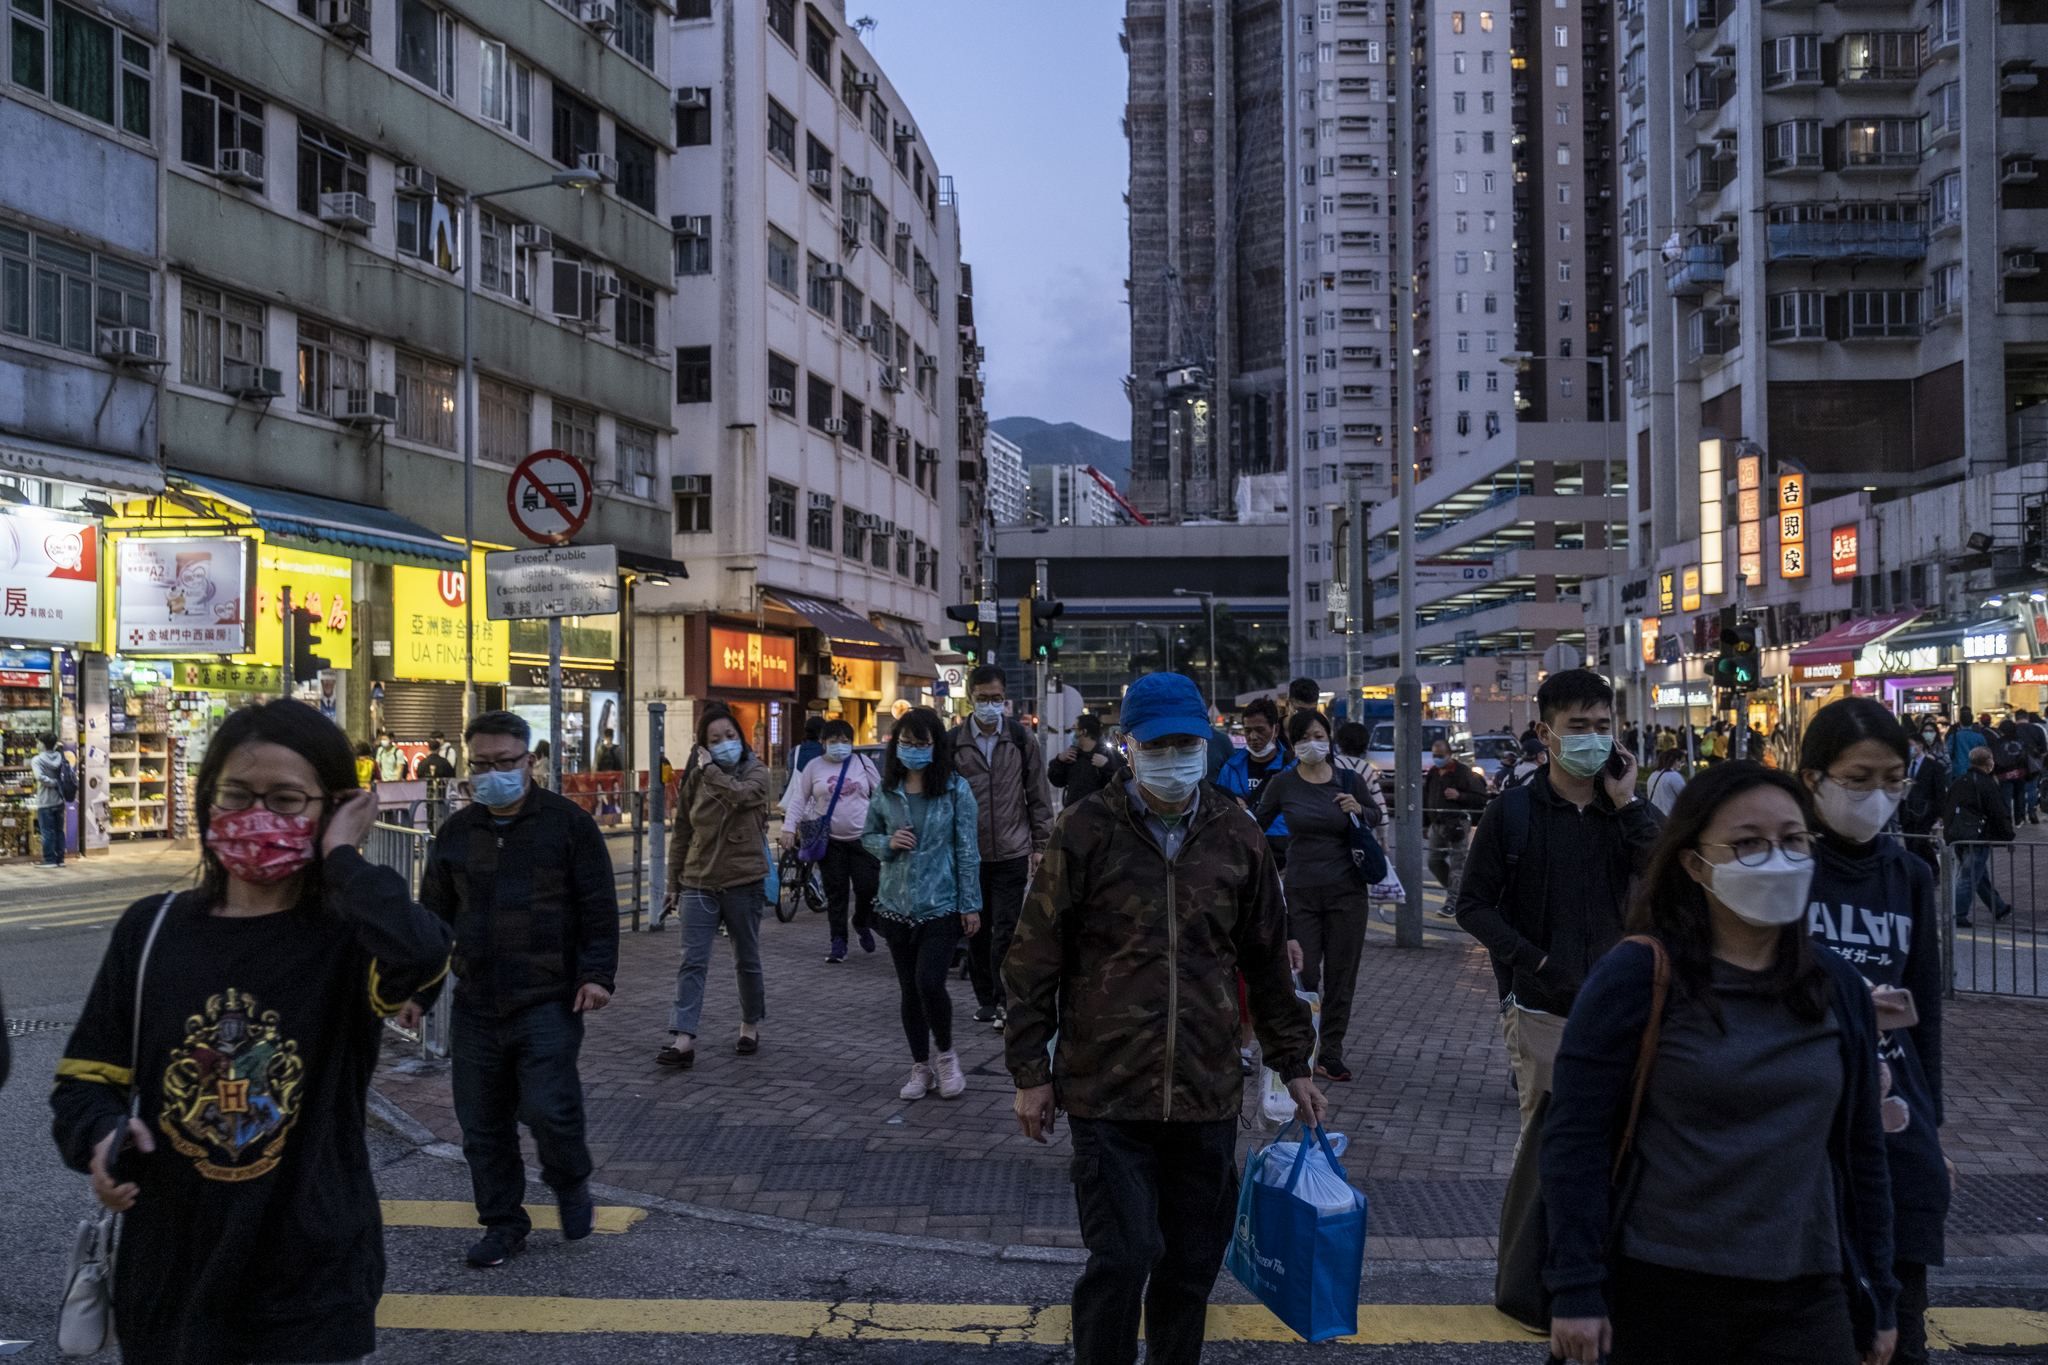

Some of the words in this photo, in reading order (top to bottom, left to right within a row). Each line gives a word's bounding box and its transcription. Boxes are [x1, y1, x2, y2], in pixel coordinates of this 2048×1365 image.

[1740, 462, 1758, 549] 阿信屋
[514, 552, 549, 564] Except
[554, 550, 586, 562] public
[150, 566, 165, 577] A2
[521, 568, 546, 579] light
[496, 583, 553, 597] (scheduled
[560, 576, 607, 591] services)
[30, 607, 63, 620] 有限公司
[411, 641, 432, 663] UA
[436, 643, 494, 667] FINANCE
[223, 1082, 242, 1111] H
